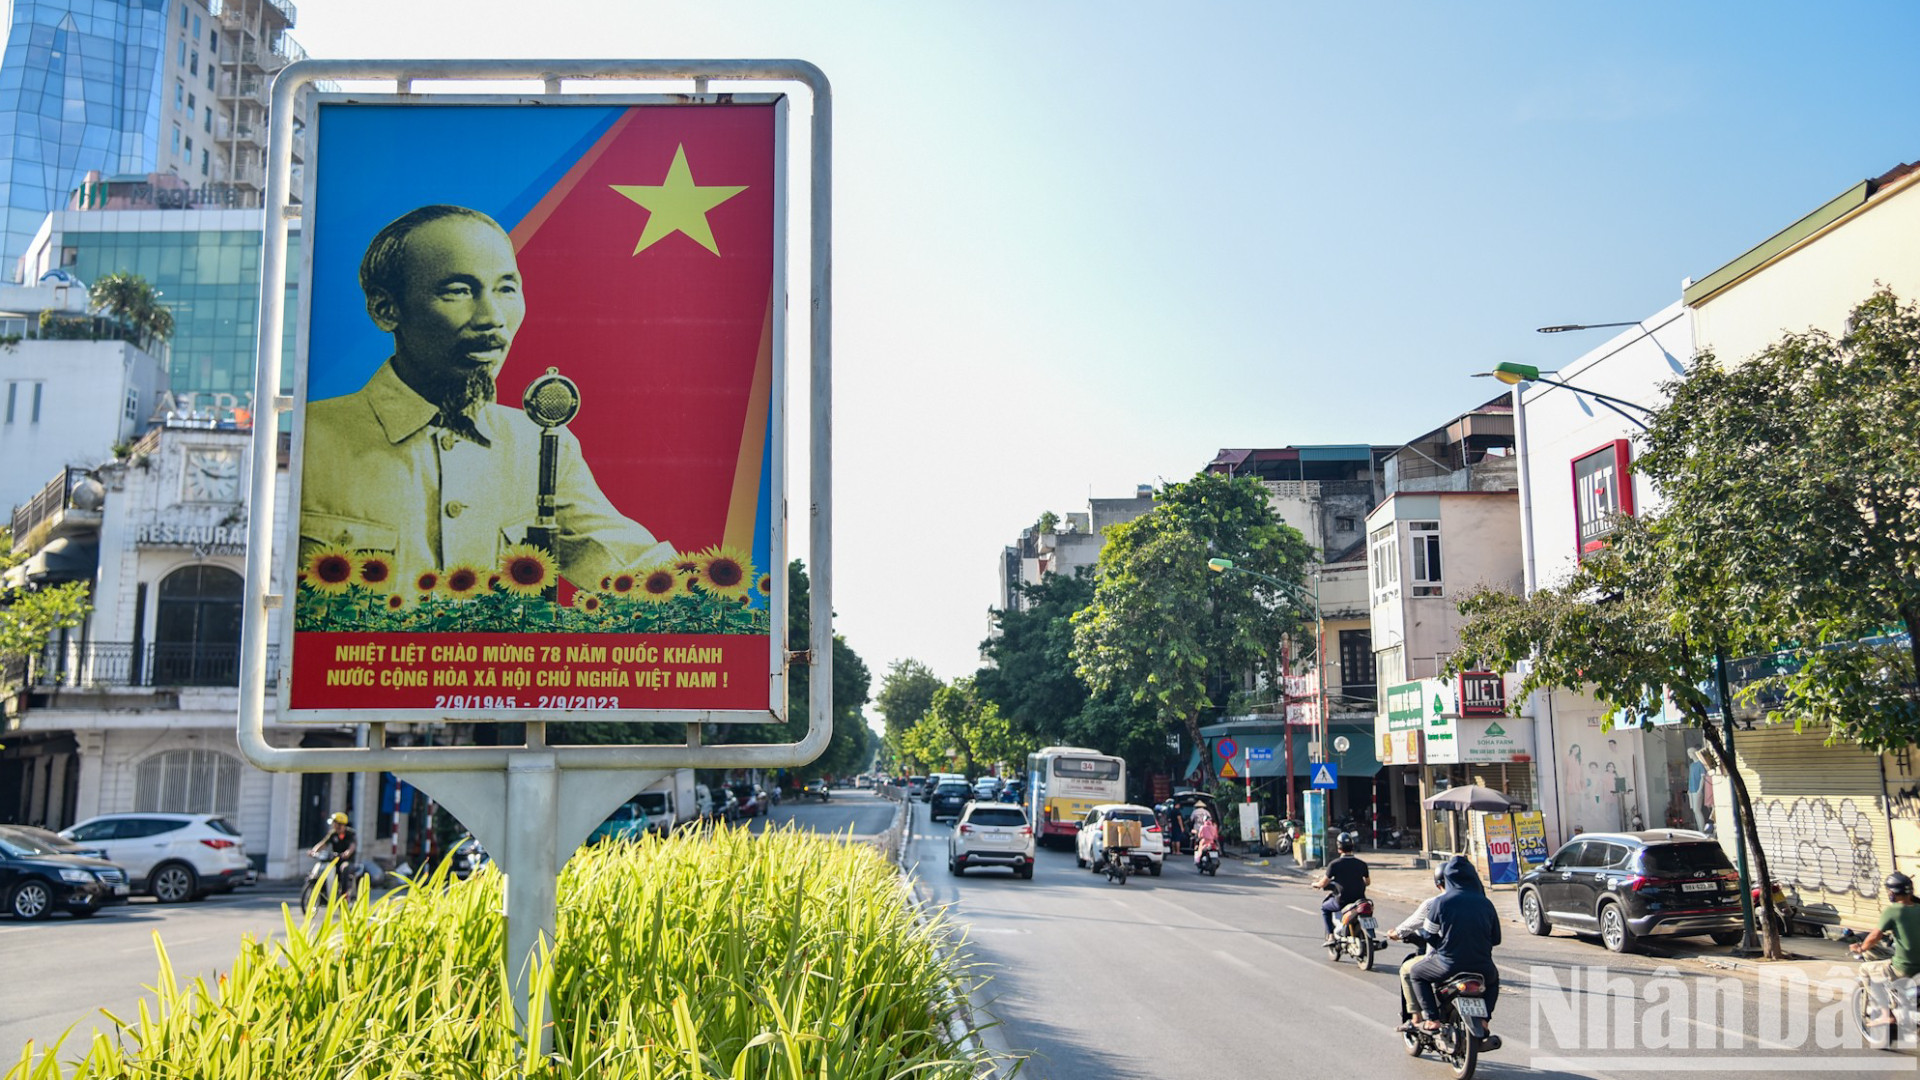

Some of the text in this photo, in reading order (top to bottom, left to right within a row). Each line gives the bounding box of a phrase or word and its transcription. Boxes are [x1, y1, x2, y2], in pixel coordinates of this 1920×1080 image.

[1579, 465, 1613, 524] VIET
[136, 523, 248, 545] RESTAURA
[335, 641, 722, 666] NHIỆT LIỆT CHÀO MỪNG 78 NĂM QUỐC KHÁNH
[326, 665, 728, 691] NƯỚC CỘNG HÒA XÃ HỘI CHỦ NGHĨA VIỆT NAM !
[1464, 679, 1500, 701] VIET
[435, 695, 516, 710] 2/9/1945
[538, 696, 619, 710] 2/9/2023
[1082, 762, 1093, 770] 34
[1489, 842, 1510, 855] 100
[1518, 836, 1545, 850] 35K
